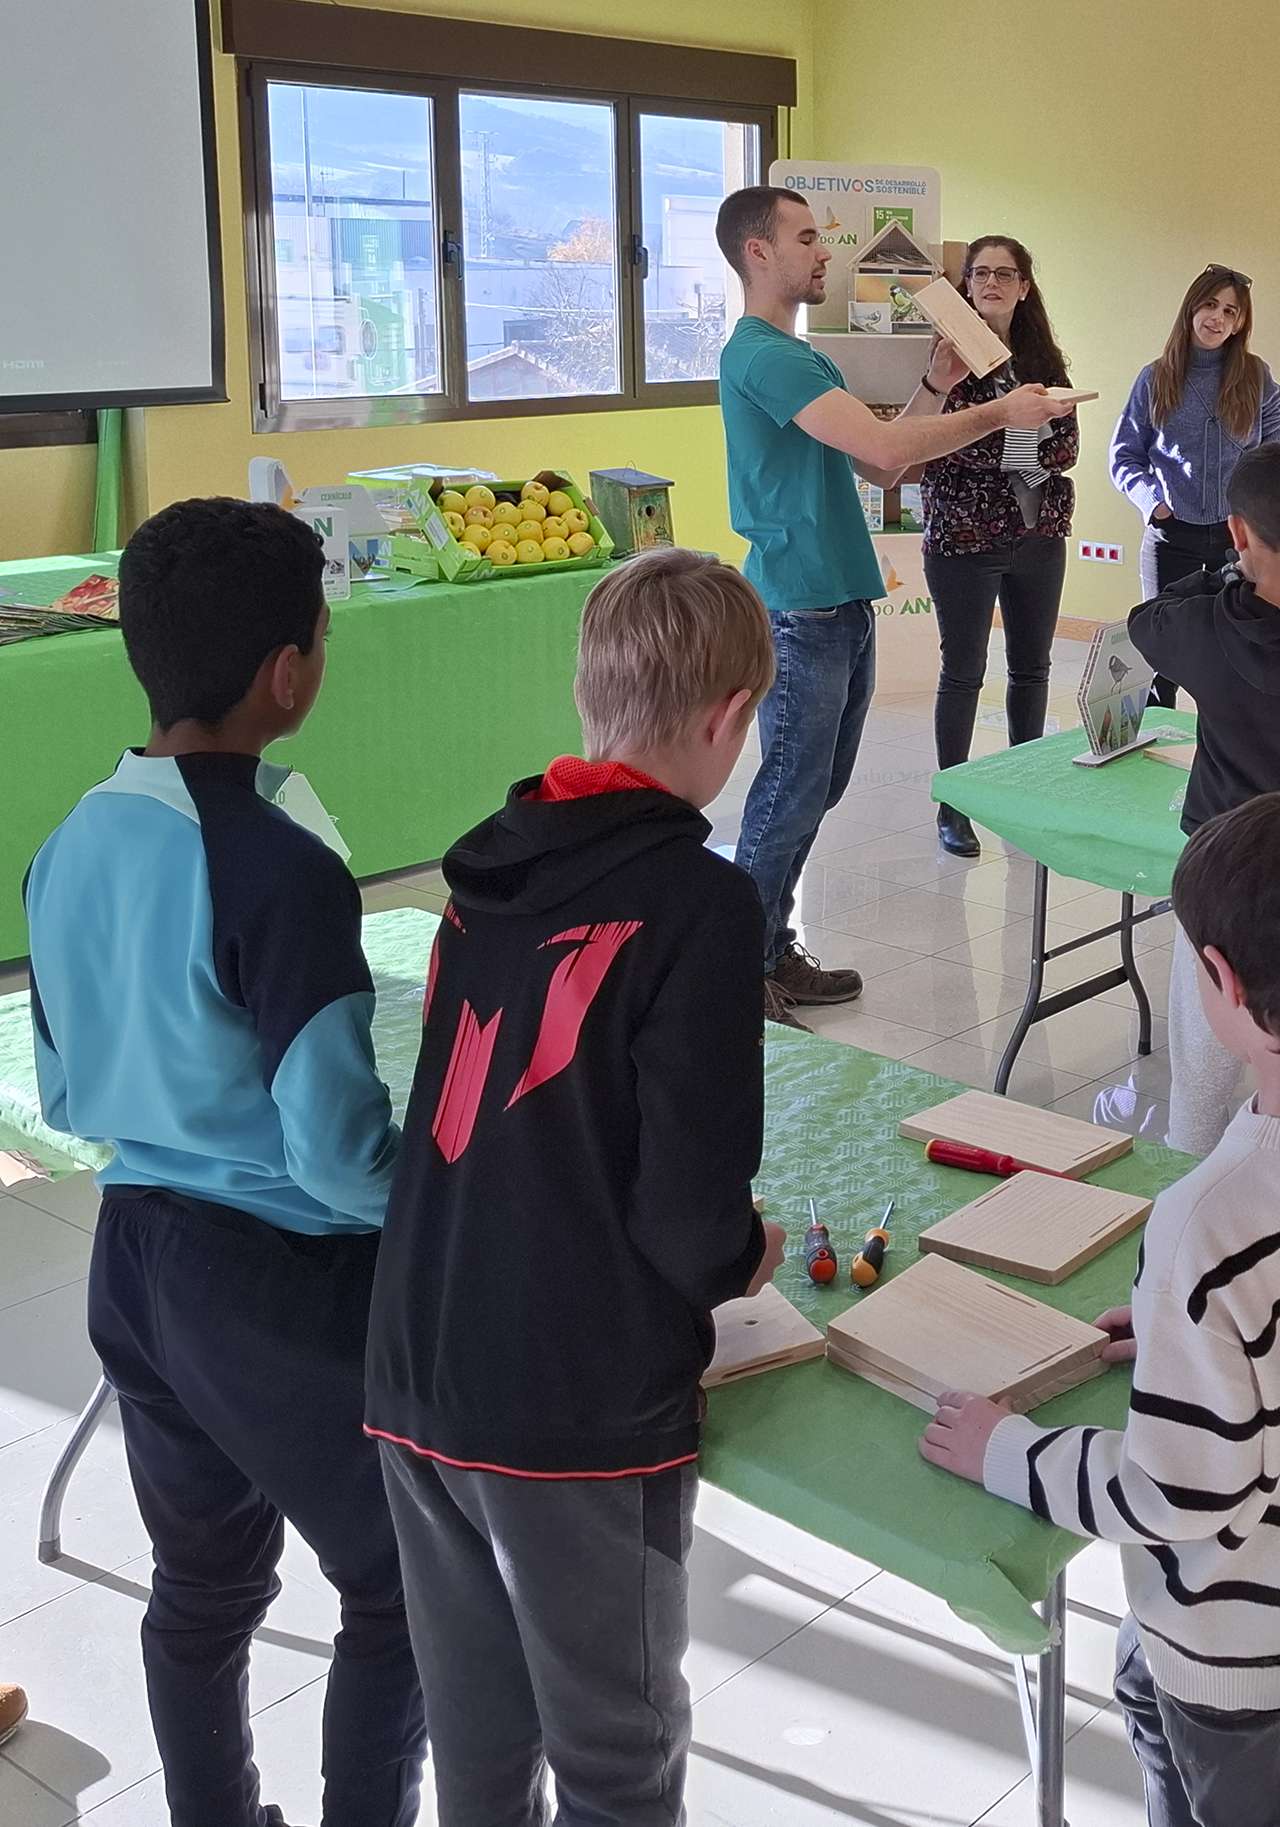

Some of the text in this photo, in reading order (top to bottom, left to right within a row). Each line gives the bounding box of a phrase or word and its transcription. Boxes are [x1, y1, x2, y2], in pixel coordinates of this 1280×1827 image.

[784, 175, 874, 193] OBJETIVOS
[885, 180, 926, 188] DESARROLLO
[876, 186, 926, 195] SOSTENIBLE
[875, 210, 884, 220] 15
[837, 234, 857, 245] AN
[900, 597, 931, 615] AN
